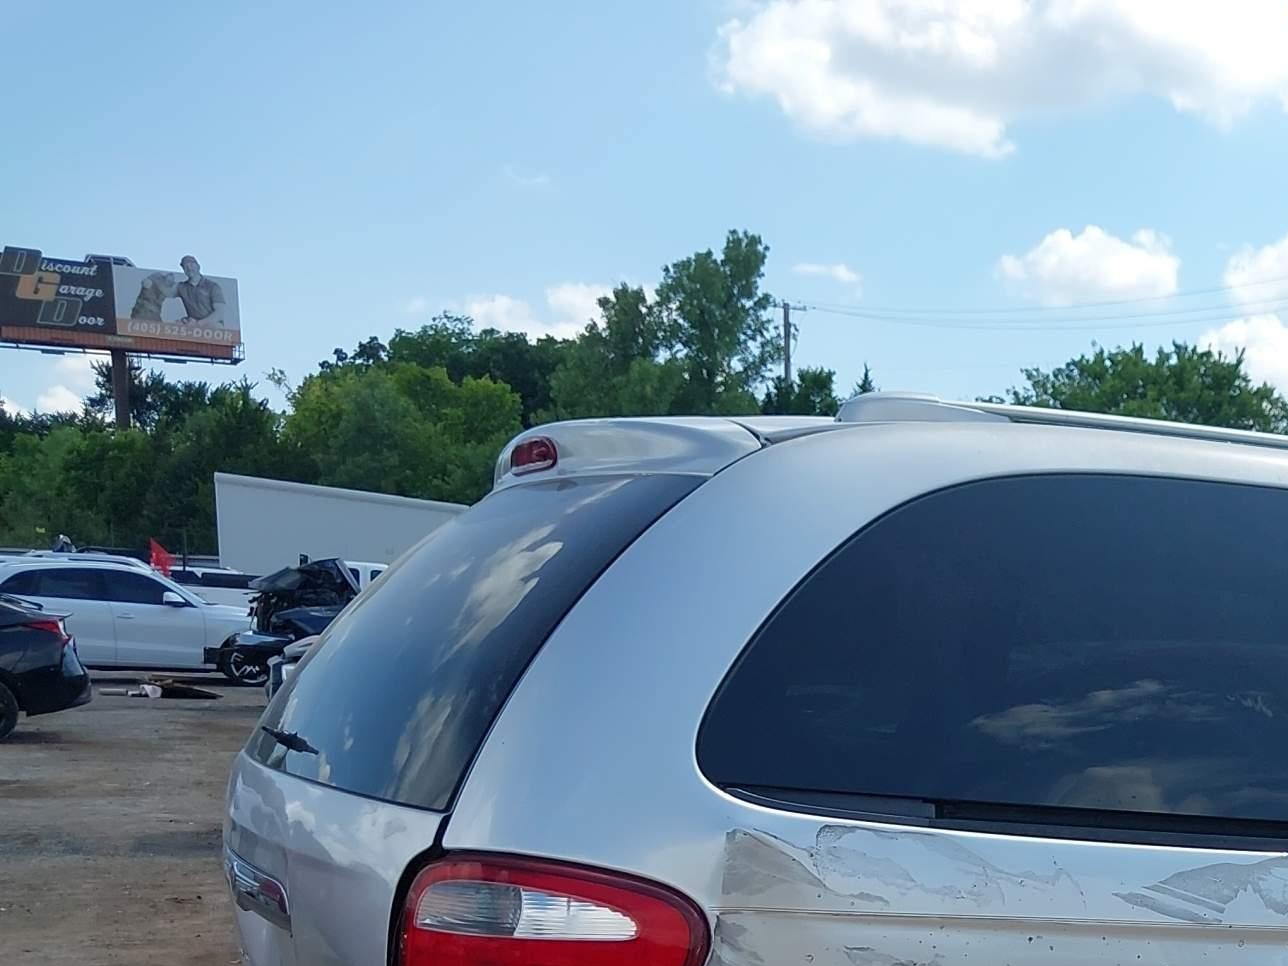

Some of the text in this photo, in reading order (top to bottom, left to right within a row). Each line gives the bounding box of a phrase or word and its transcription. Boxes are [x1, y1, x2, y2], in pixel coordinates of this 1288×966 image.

[0, 246, 98, 277] Discount
[16, 271, 104, 302] Garage
[37, 296, 105, 327] Door
[127, 320, 161, 336] (405)
